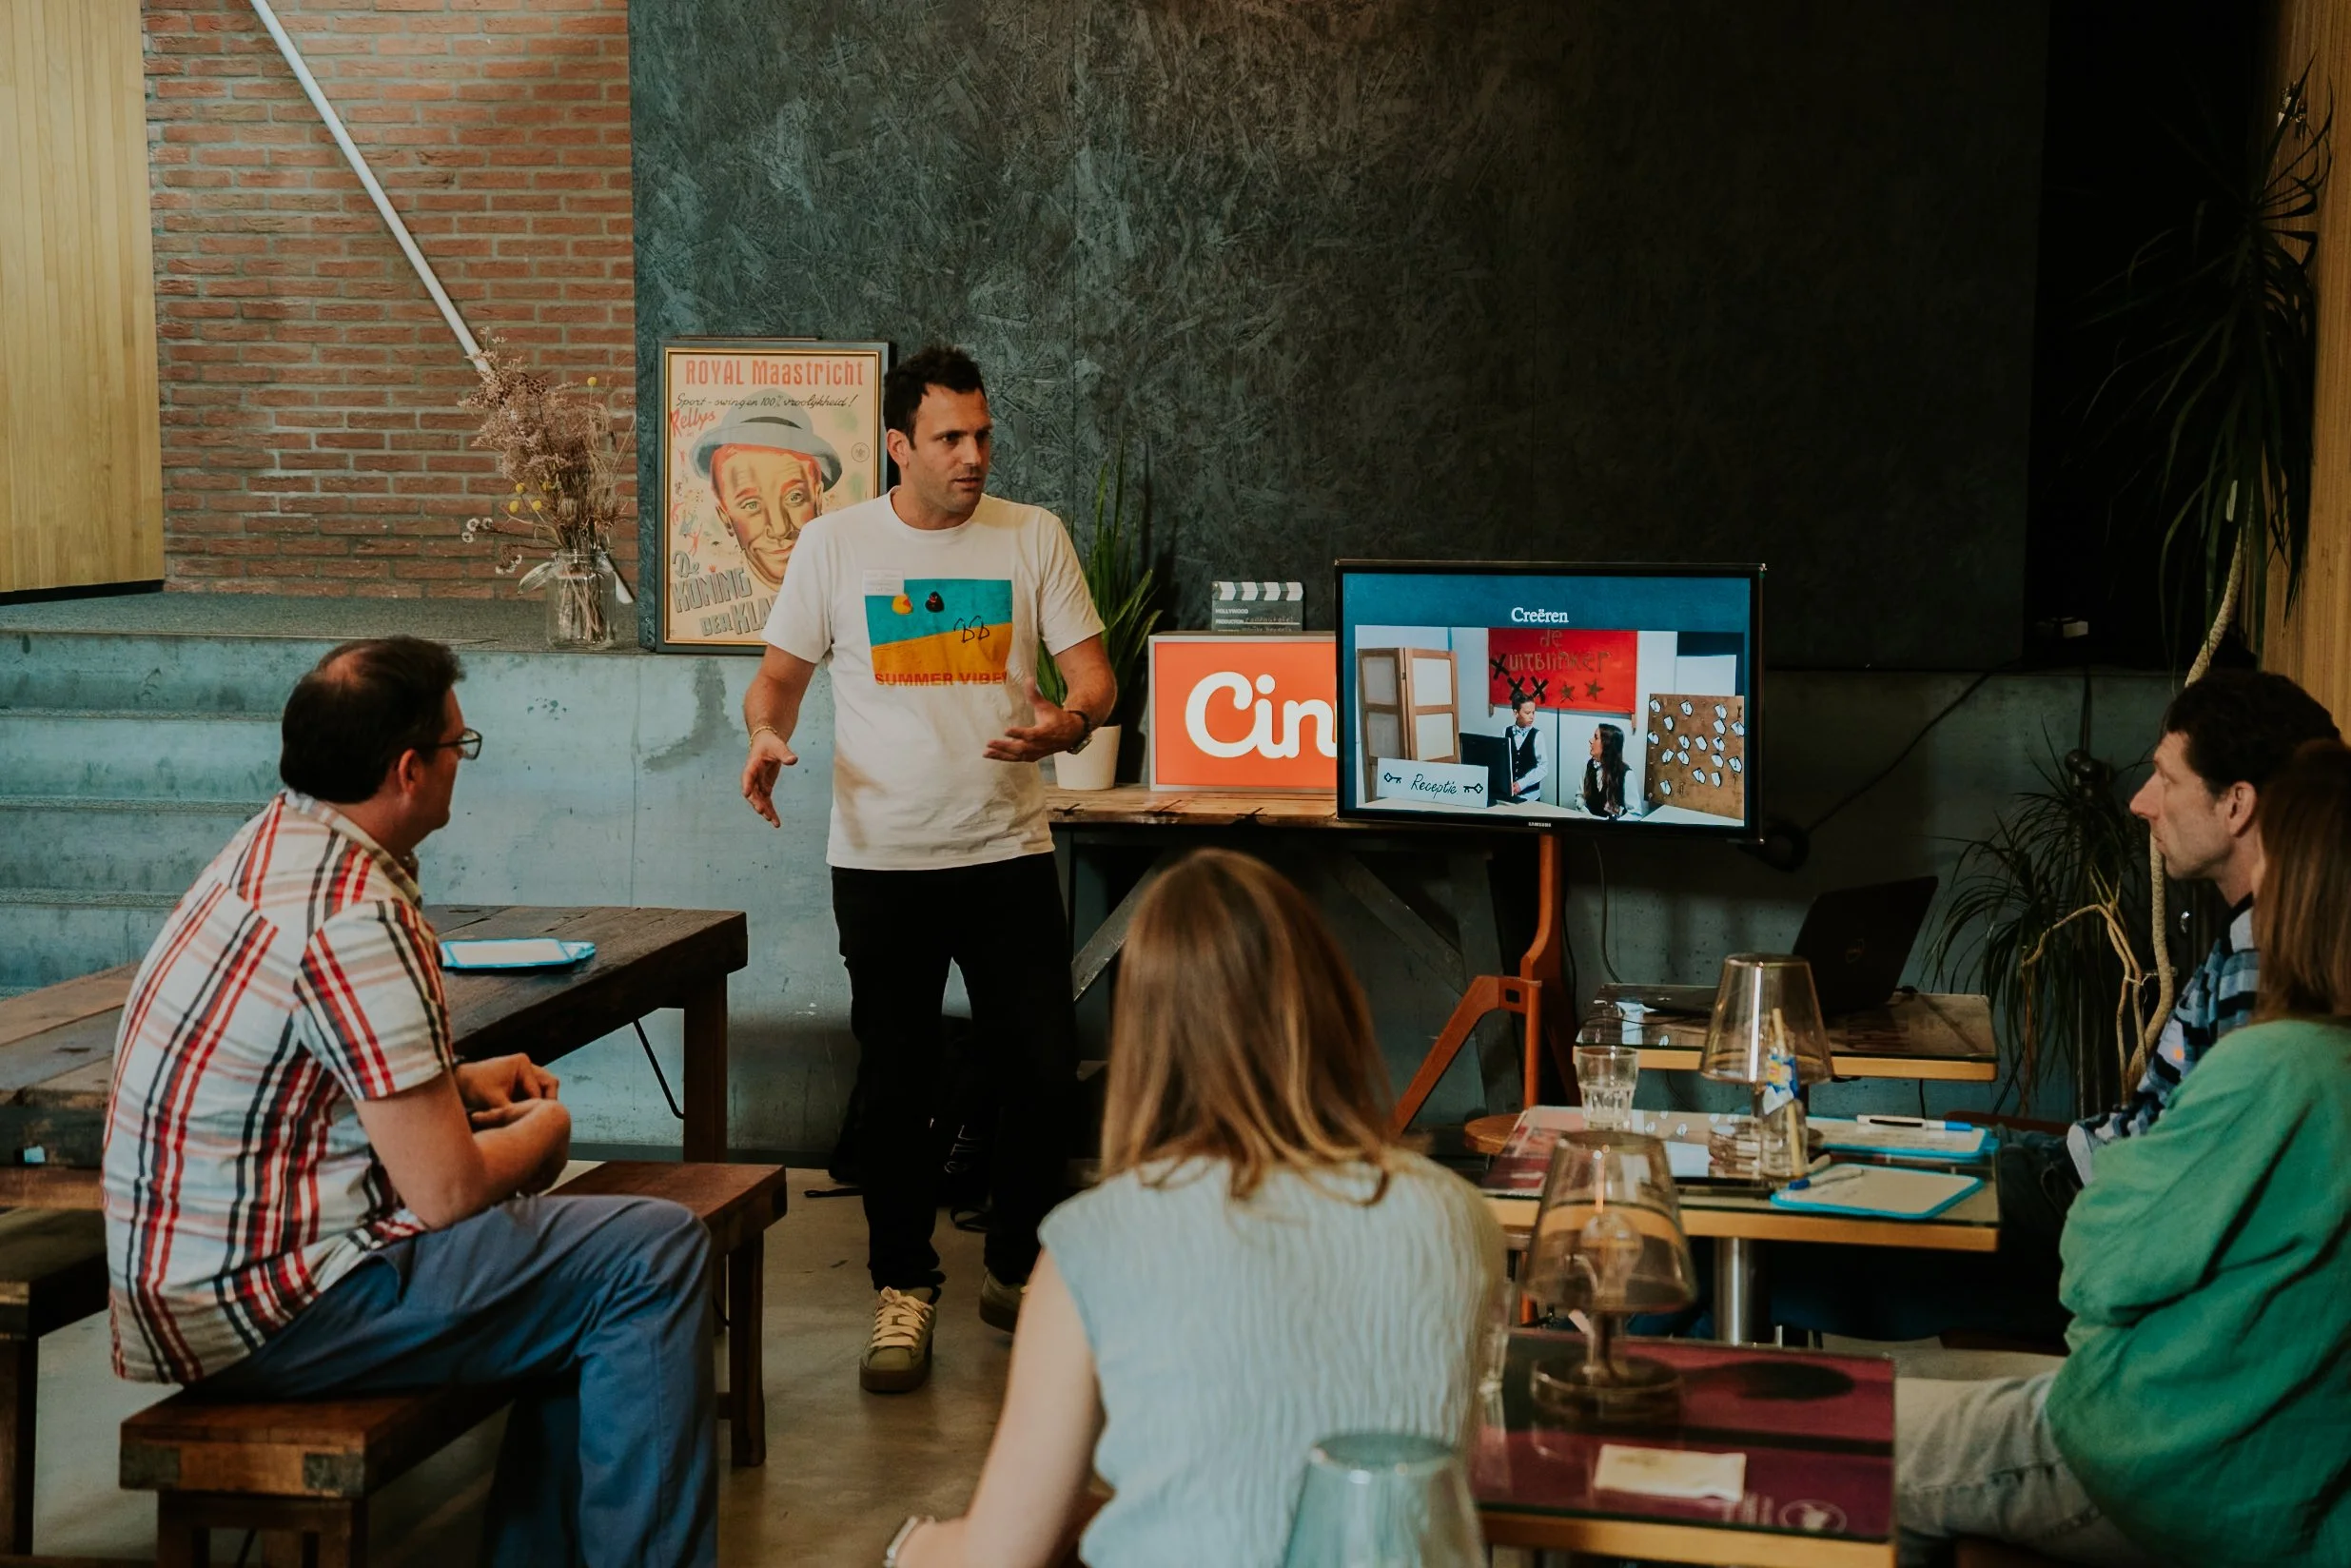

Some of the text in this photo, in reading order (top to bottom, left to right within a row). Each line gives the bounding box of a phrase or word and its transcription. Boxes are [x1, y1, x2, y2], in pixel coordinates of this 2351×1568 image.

[685, 360, 864, 386] ROYAL Maastricht
[672, 550, 700, 578] De
[670, 566, 753, 614] KONING
[699, 594, 778, 637] DER KLA
[1215, 607, 1249, 616] HOLLYWOOD
[1511, 606, 1569, 623] Creëren
[874, 672, 954, 687] SUMMER
[1185, 671, 1338, 759] Cin
[1410, 773, 1458, 800] Receptie
